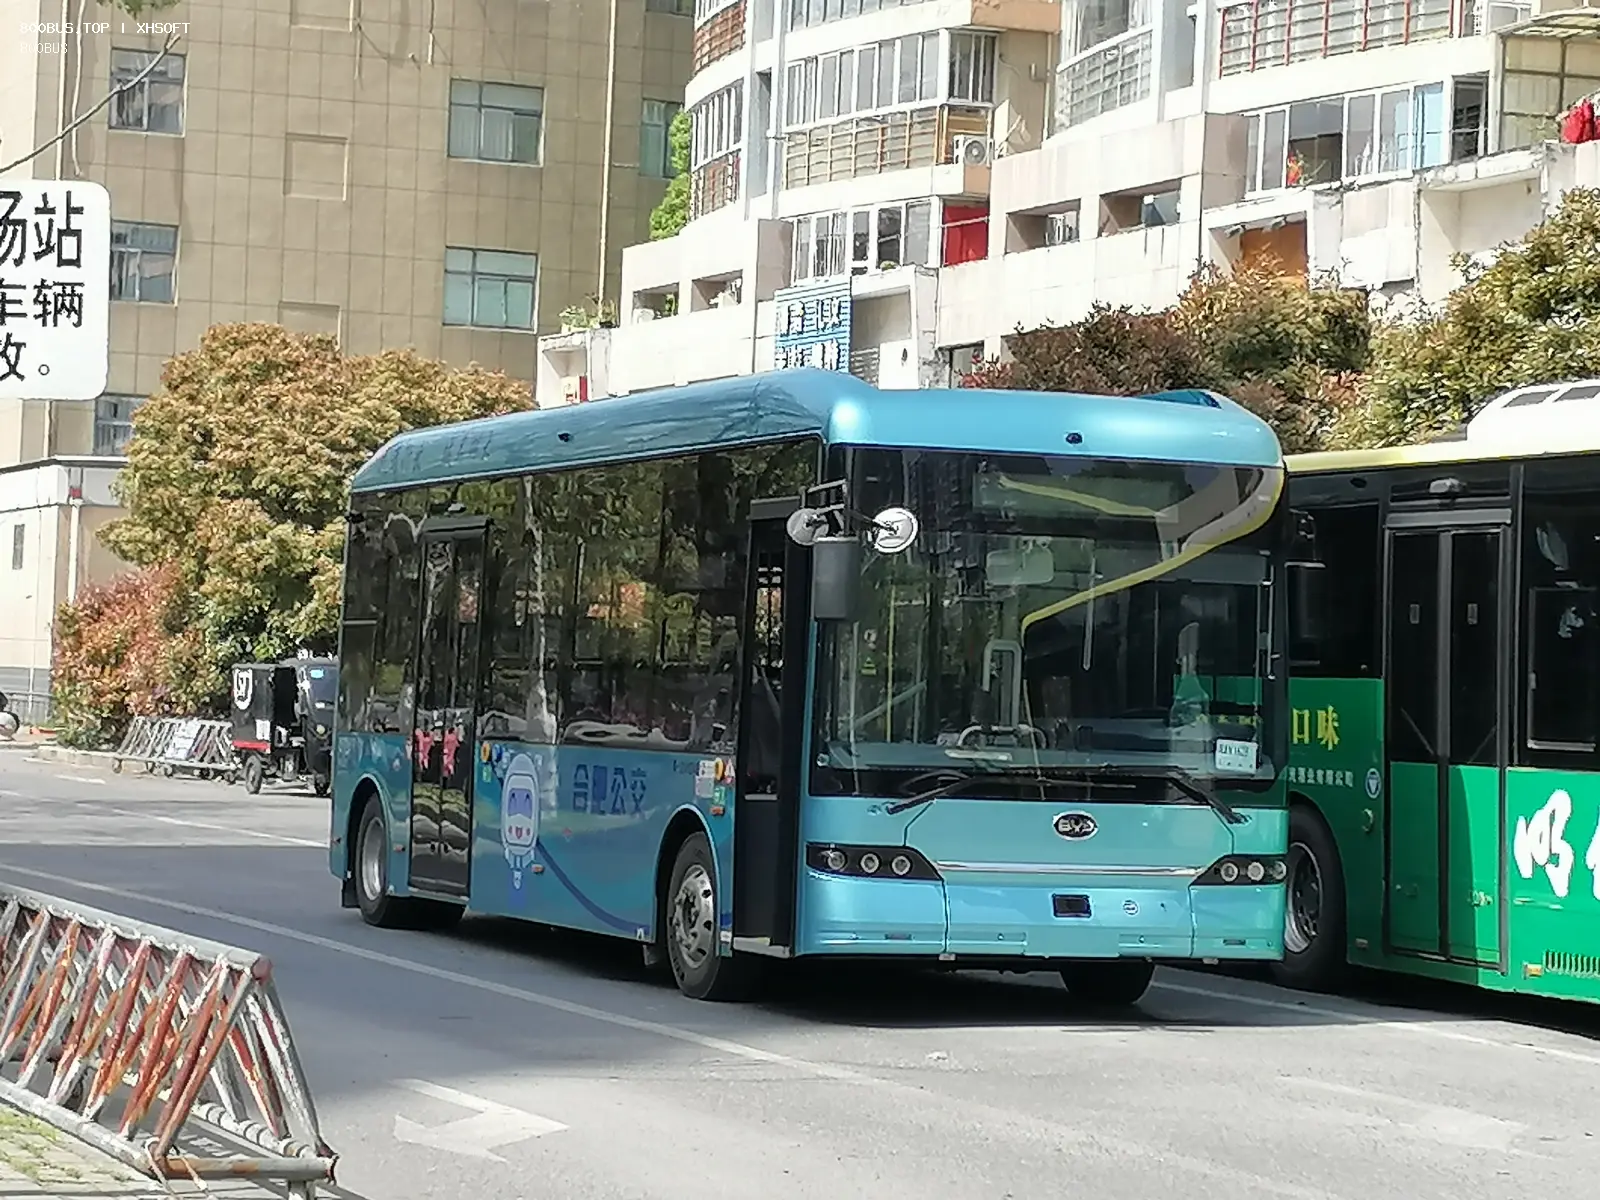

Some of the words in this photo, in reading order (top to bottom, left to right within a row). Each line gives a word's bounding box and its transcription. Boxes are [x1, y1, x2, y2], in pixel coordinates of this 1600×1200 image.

[0, 190, 84, 268] 场站
[0, 278, 85, 328] 车辆
[1292, 705, 1340, 751] 口味
